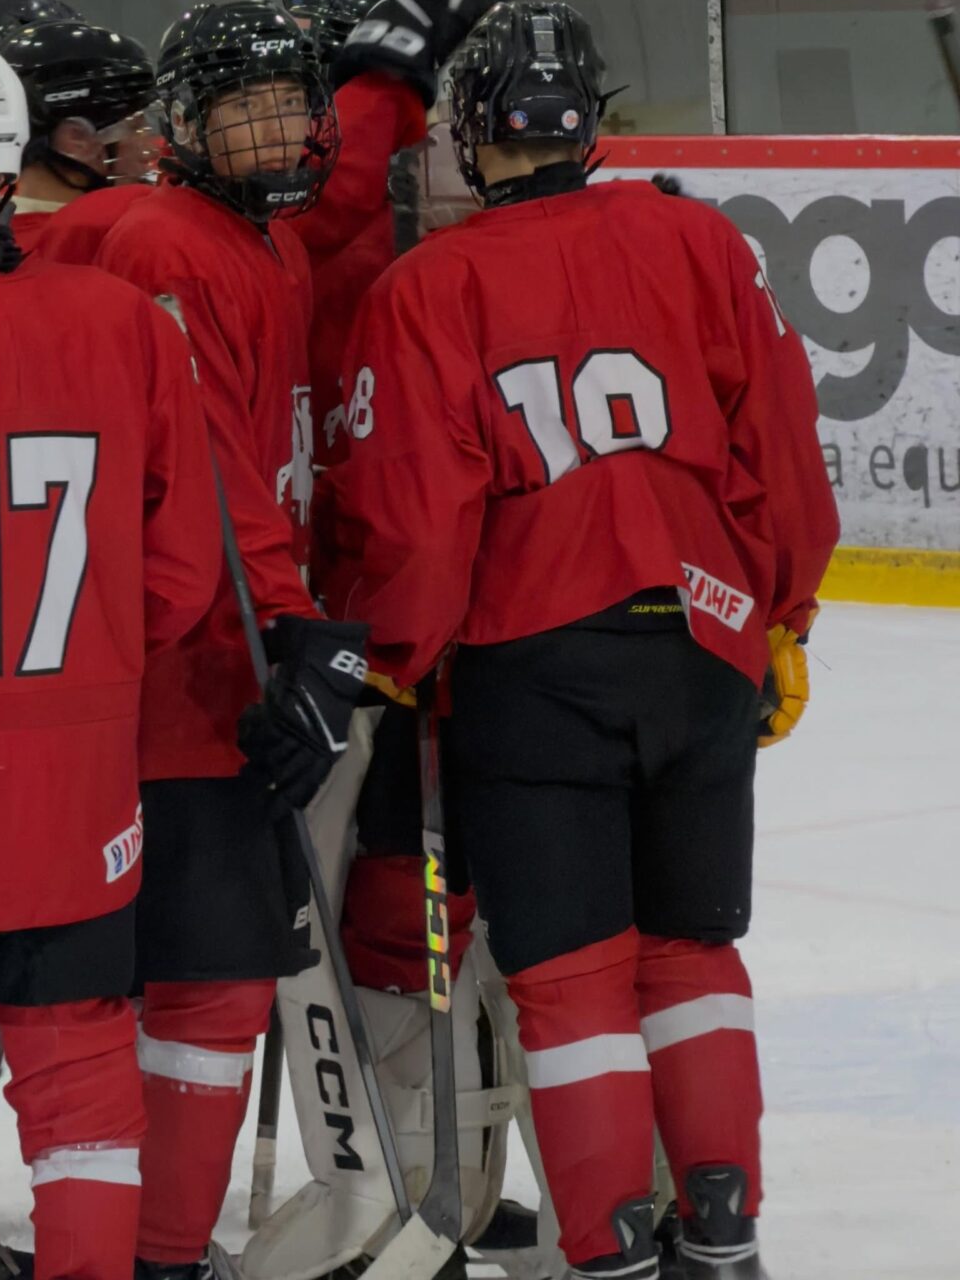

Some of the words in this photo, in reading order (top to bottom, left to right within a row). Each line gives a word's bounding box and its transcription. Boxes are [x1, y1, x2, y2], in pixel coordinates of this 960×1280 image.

[251, 39, 295, 52] CCM
[266, 190, 307, 203] CCM
[492, 348, 672, 485] 10
[693, 575, 743, 620] IIHF
[306, 1002, 365, 1171] CCM
